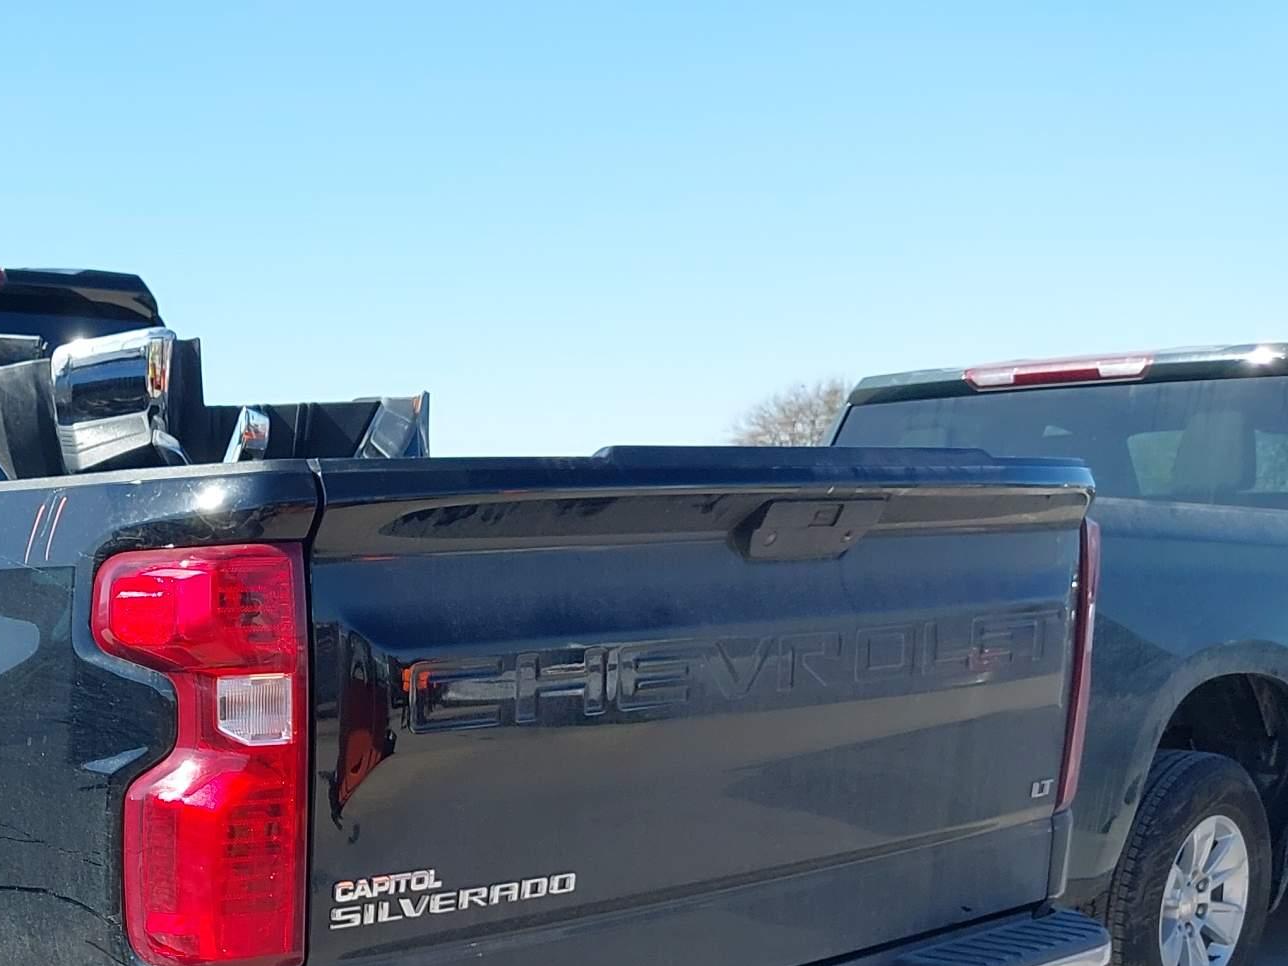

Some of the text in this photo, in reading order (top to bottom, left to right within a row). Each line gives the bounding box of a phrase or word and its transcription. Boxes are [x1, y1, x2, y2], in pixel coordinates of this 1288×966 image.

[409, 608, 1062, 735] CHEVROLET
[1031, 778, 1054, 798] LT
[329, 872, 577, 930] SILVERADO
[335, 869, 443, 902] CAPITOL
